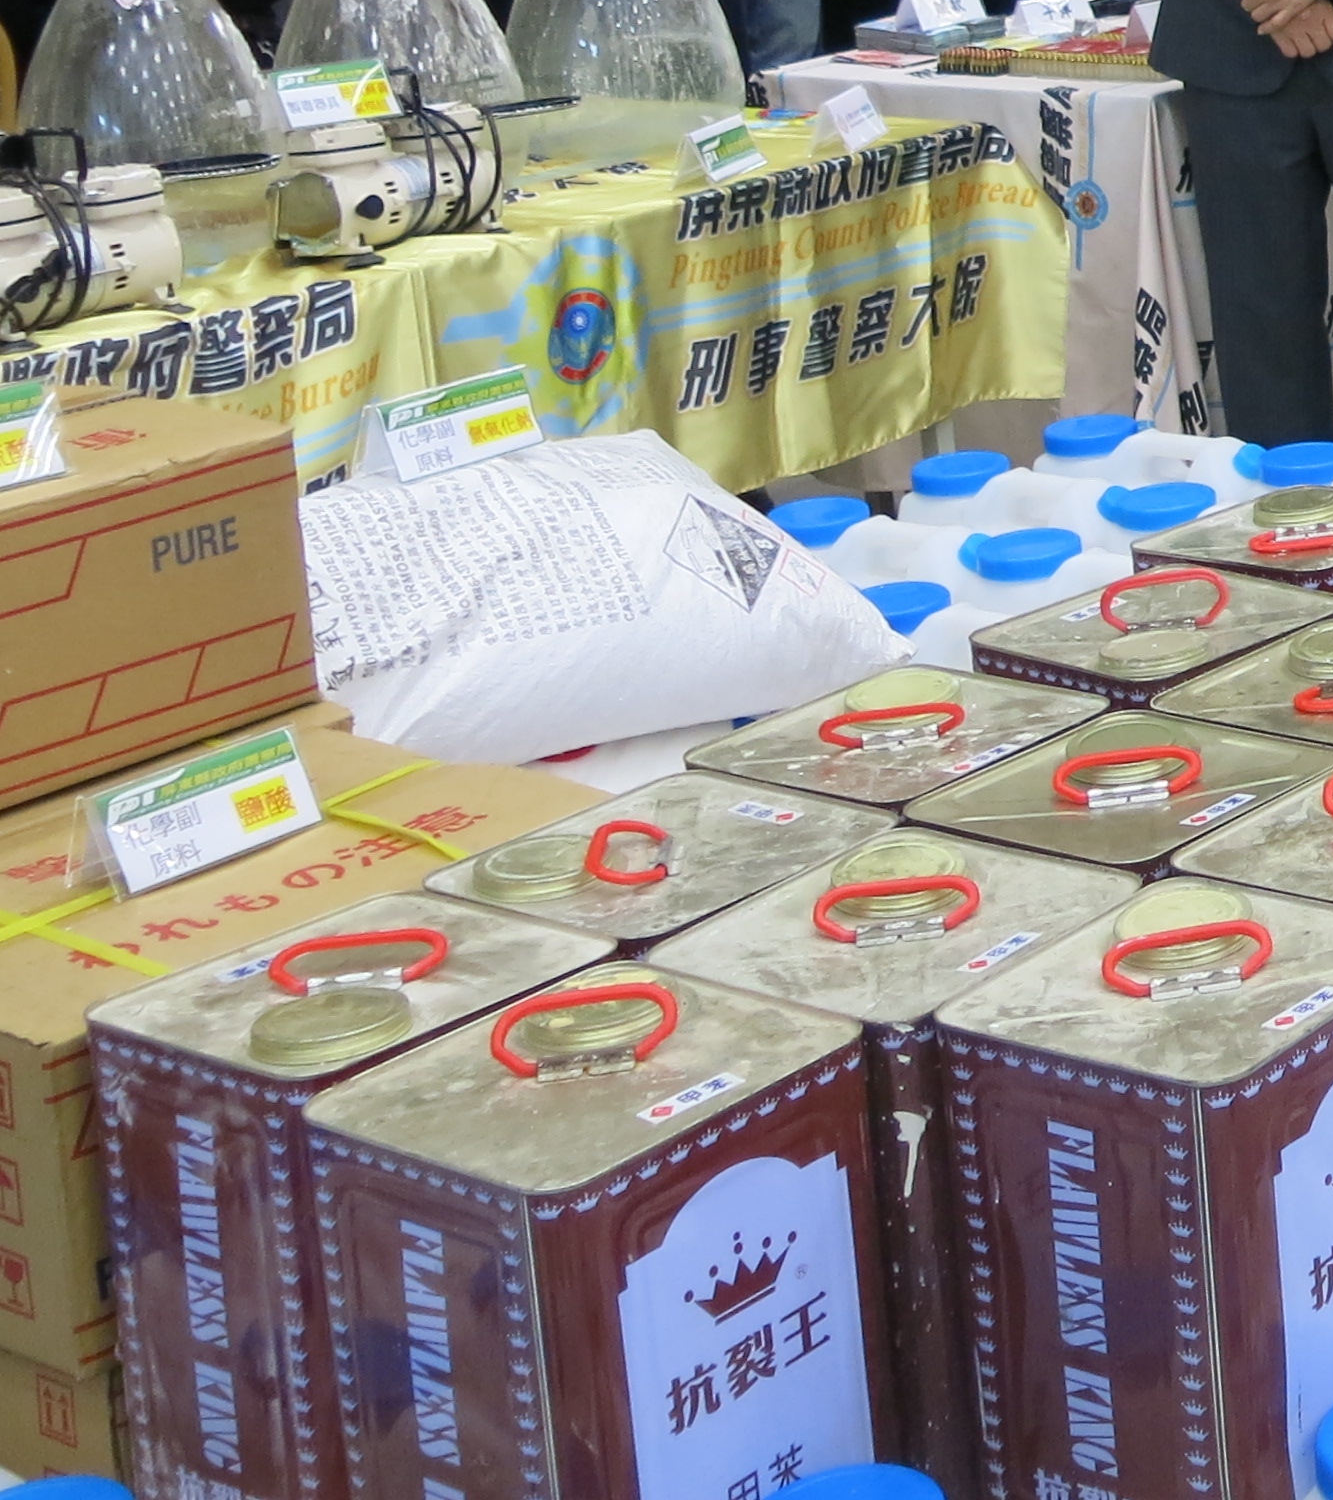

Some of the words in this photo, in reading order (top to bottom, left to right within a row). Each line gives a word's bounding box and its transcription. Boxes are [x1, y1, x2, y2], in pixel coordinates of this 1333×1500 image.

[669, 236, 787, 290] Pingtung
[795, 217, 875, 262] County
[957, 180, 1040, 218] Bureau
[677, 121, 1016, 241] 屏東縣政府警察局
[279, 352, 382, 424] Bureau
[677, 253, 989, 413] 刑事警察大隊
[151, 516, 240, 574] PURE
[616, 595, 636, 622] CAS
[234, 784, 297, 829] 鹽酸
[174, 1113, 231, 1350] FLAWLESS
[1046, 1117, 1110, 1356] FLAWLESS
[399, 1218, 463, 1468] FLAWLESS
[664, 1289, 832, 1437] 抗裂王
[193, 1360, 243, 1474] KING
[1063, 1364, 1119, 1479] KING
